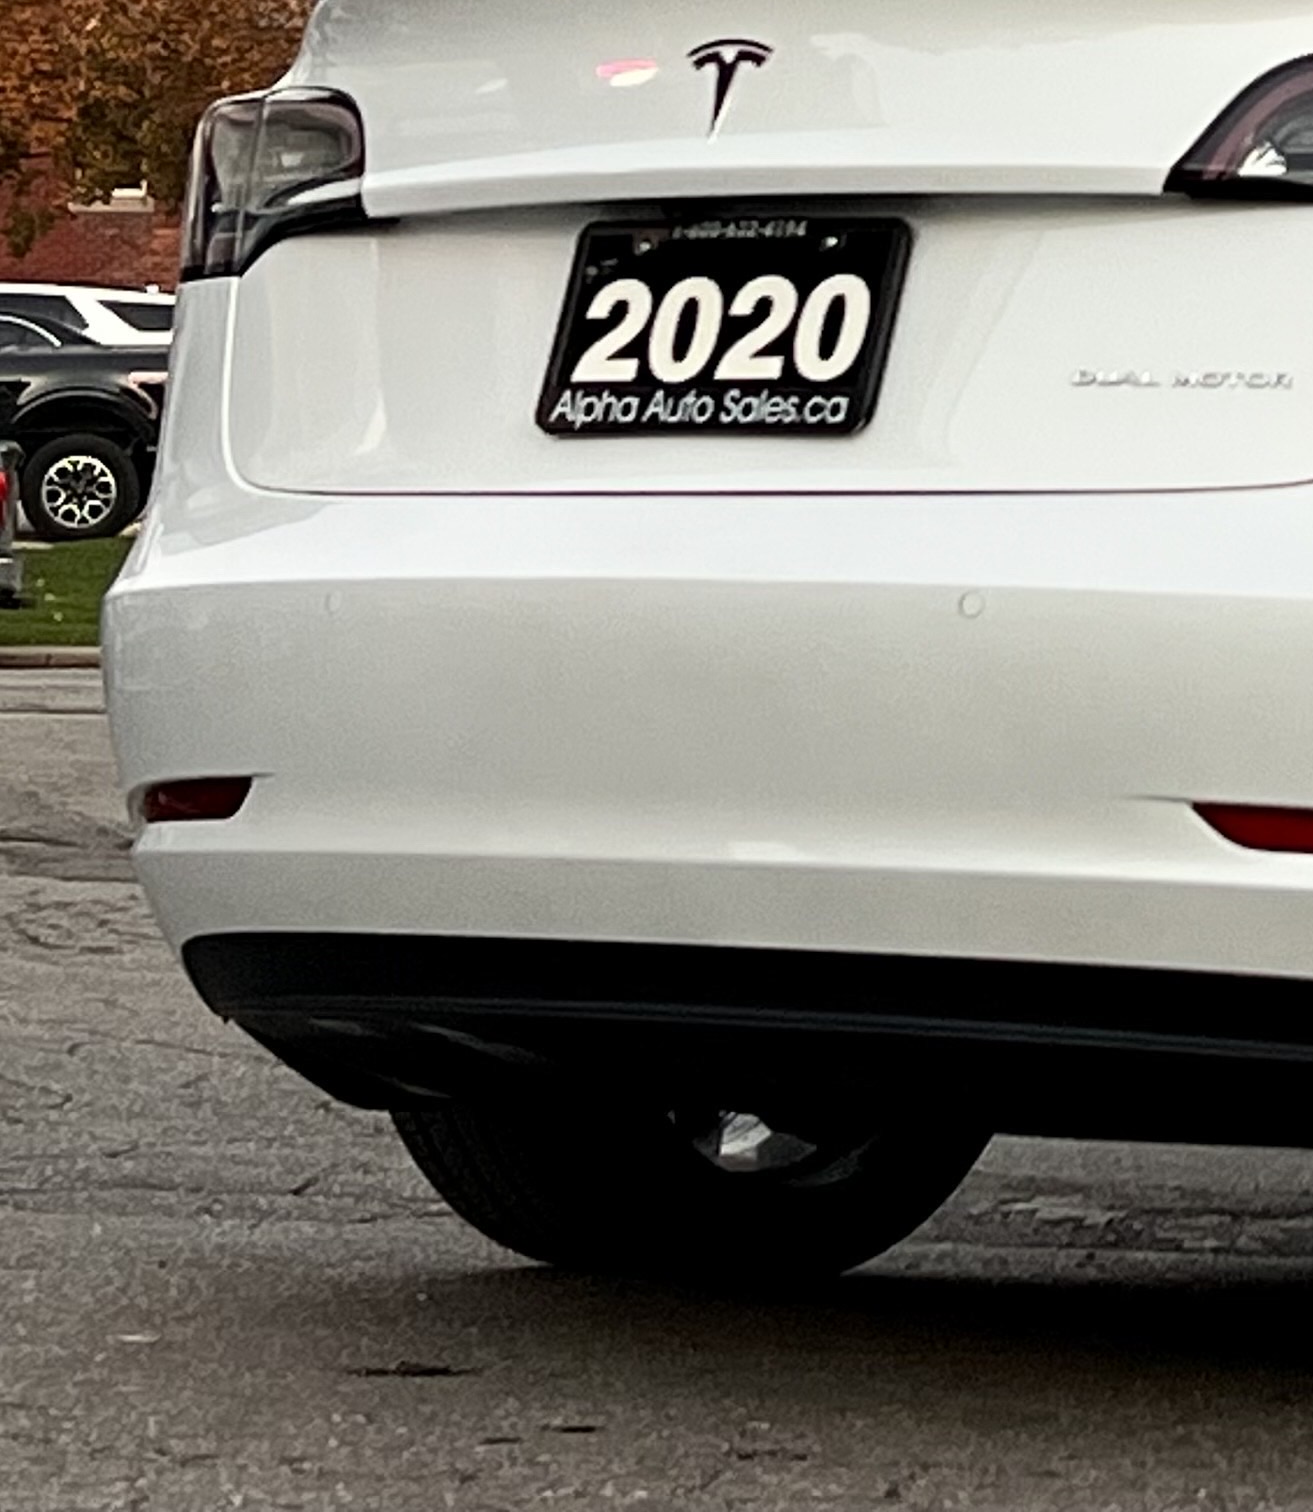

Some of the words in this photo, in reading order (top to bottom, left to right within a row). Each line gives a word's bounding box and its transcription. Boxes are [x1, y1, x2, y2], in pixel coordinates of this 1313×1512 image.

[570, 274, 871, 383] 2020
[1070, 368, 1161, 387] DUAL
[1172, 370, 1294, 389] MOTOR
[550, 389, 640, 431] Alpha
[641, 389, 714, 424] Auto
[719, 388, 849, 424] Sales.ca
